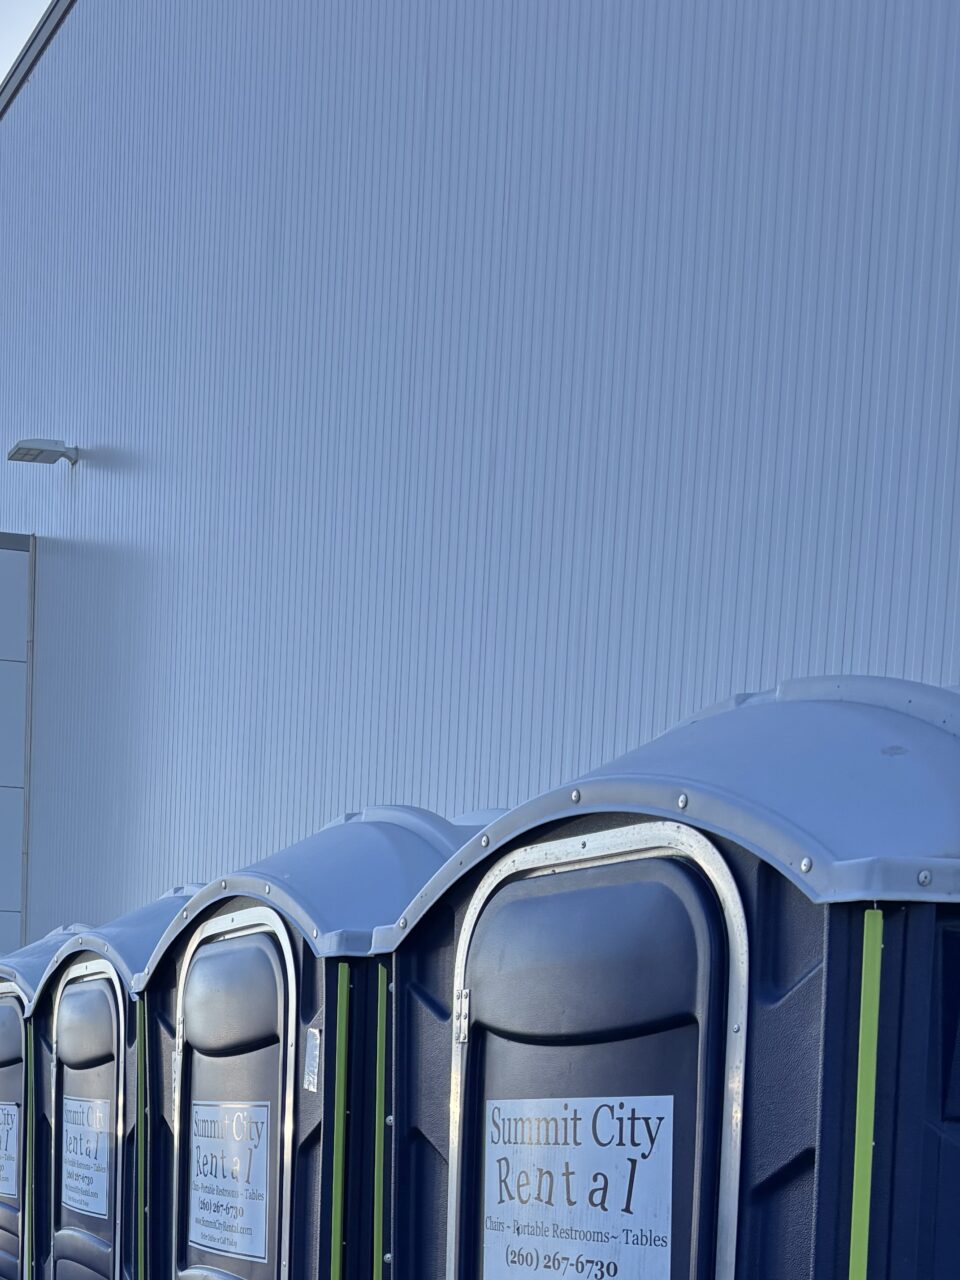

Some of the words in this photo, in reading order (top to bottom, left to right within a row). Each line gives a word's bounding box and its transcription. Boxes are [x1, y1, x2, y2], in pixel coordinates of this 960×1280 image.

[232, 1111, 265, 1149] City
[490, 1103, 582, 1147] Summit
[591, 1101, 665, 1160] City
[195, 1145, 253, 1185] Rental
[244, 1188, 265, 1201] Tables
[496, 1156, 638, 1215] Rental
[198, 1197, 211, 1214] (260)
[212, 1200, 245, 1220] 267-6730
[485, 1216, 505, 1232] Chairs
[513, 1219, 550, 1237] Portable
[622, 1228, 668, 1248] Tables
[505, 1244, 540, 1271] (260)
[543, 1251, 618, 1280] 267-6730
